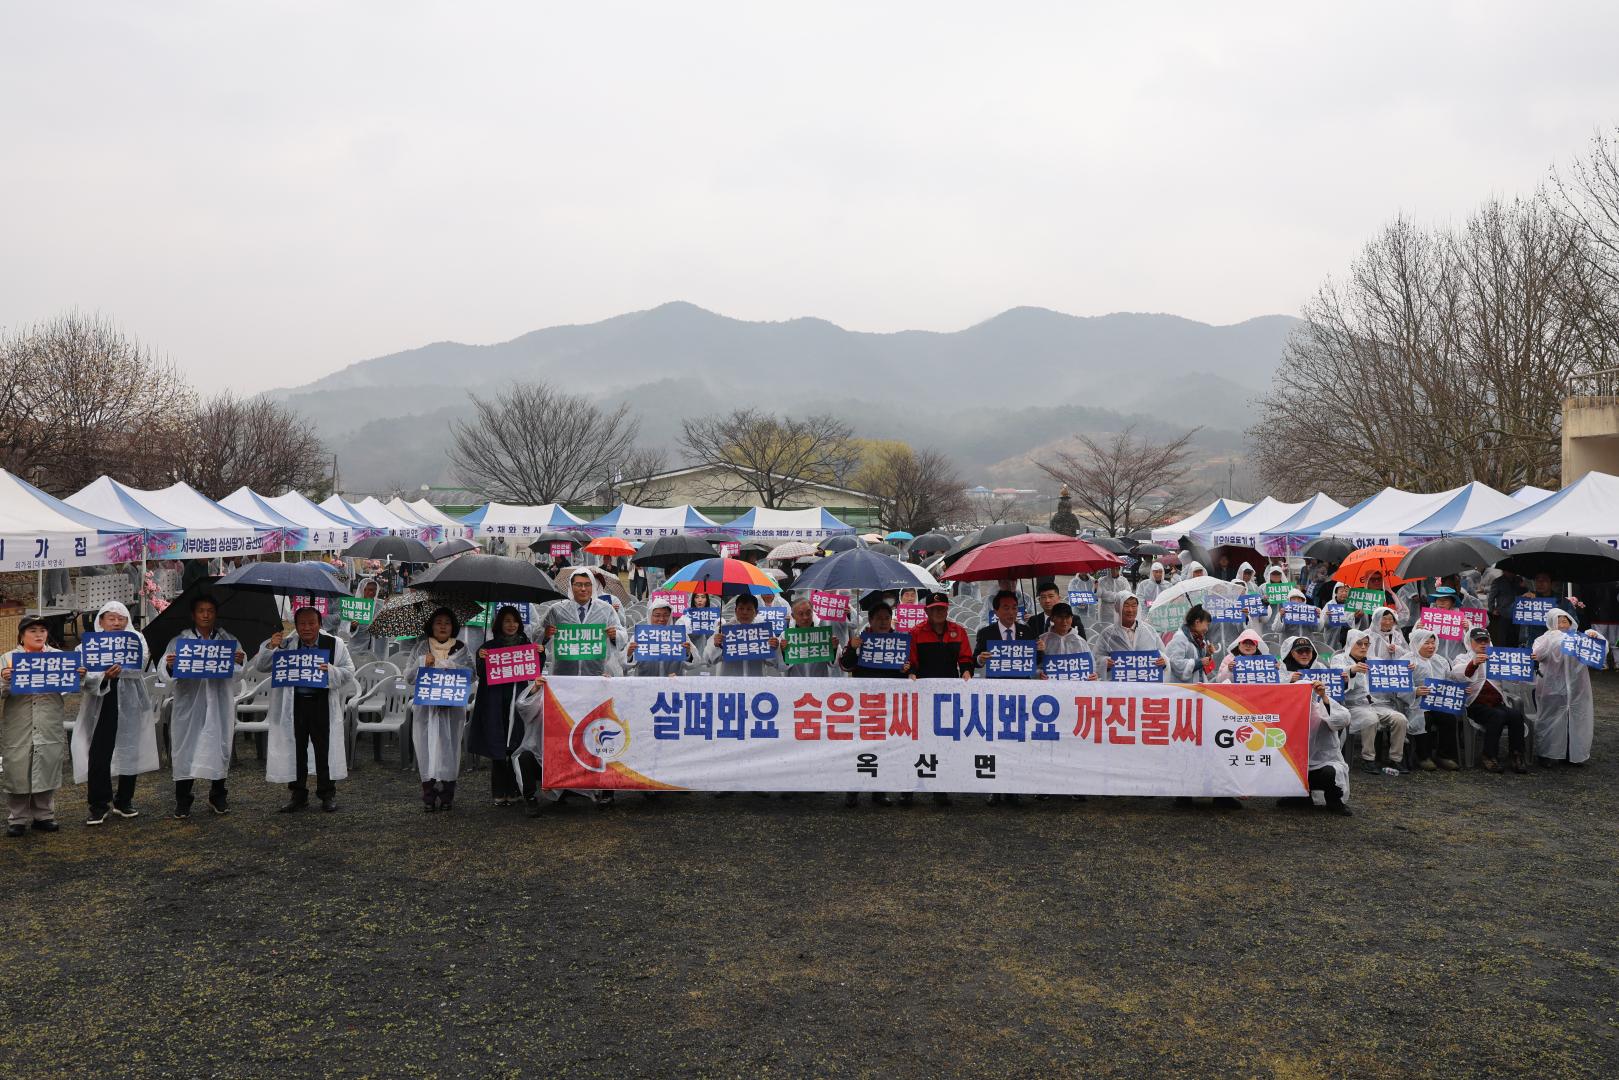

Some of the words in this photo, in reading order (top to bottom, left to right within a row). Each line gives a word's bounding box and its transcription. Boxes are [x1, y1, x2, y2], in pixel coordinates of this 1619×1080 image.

[813, 594, 846, 608] 작은관심
[1350, 591, 1382, 602] 자나깨나
[342, 600, 371, 610] 자나깨나
[1284, 604, 1316, 613] 소각없는
[1516, 600, 1552, 611] 소각없는
[899, 608, 927, 618] 작은관
[1423, 612, 1461, 625] 작은관심
[557, 629, 603, 641] 자나깨나
[638, 630, 682, 642] 소각없는
[726, 628, 769, 642] 소각없는
[788, 631, 830, 645] 자나깨나
[86, 636, 139, 650] 소각없는
[557, 643, 602, 656] 산불조심
[637, 643, 683, 656] 푸른옥산
[863, 637, 907, 651] 소각없는
[179, 644, 232, 659] 소각없는
[489, 648, 536, 665] 작은관심
[726, 644, 770, 657] 푸른옥산
[788, 645, 830, 659] 산불조심
[990, 645, 1034, 658] 소각없는
[86, 651, 139, 666] 푸른옥산
[276, 654, 325, 668] 소각없는
[862, 651, 907, 664] 푸른옥산
[1114, 655, 1158, 668] 소각없는
[1489, 652, 1531, 665] 소각없는
[16, 658, 76, 672] 소각없는
[178, 659, 231, 673] 푸른옥산
[490, 663, 536, 680] 산불예방
[989, 659, 1034, 672] 푸른옥산
[1046, 658, 1090, 672] 소각없는
[1236, 659, 1275, 671] 소각없는
[1370, 663, 1408, 676] 소각없는
[1489, 665, 1532, 678] 푸른옥산
[15, 673, 76, 688] 푸른옥산
[274, 669, 324, 683] 푸른옥산
[420, 672, 467, 687] 소각없는
[1114, 668, 1159, 682] 푸른옥산
[1236, 671, 1276, 683] 푸른옥산
[1371, 676, 1409, 689] 푸른옥산
[418, 686, 466, 701] 푸른옥산
[1428, 682, 1465, 698] 소각없는
[1424, 695, 1463, 710] 푸른옥산
[650, 691, 779, 741] 살펴봐요
[793, 692, 919, 741] 숨은불씨
[933, 693, 1060, 743] 다시봐요
[1072, 696, 1204, 746] 꺼진불씨
[1222, 714, 1280, 723] 부여군공동브랜드
